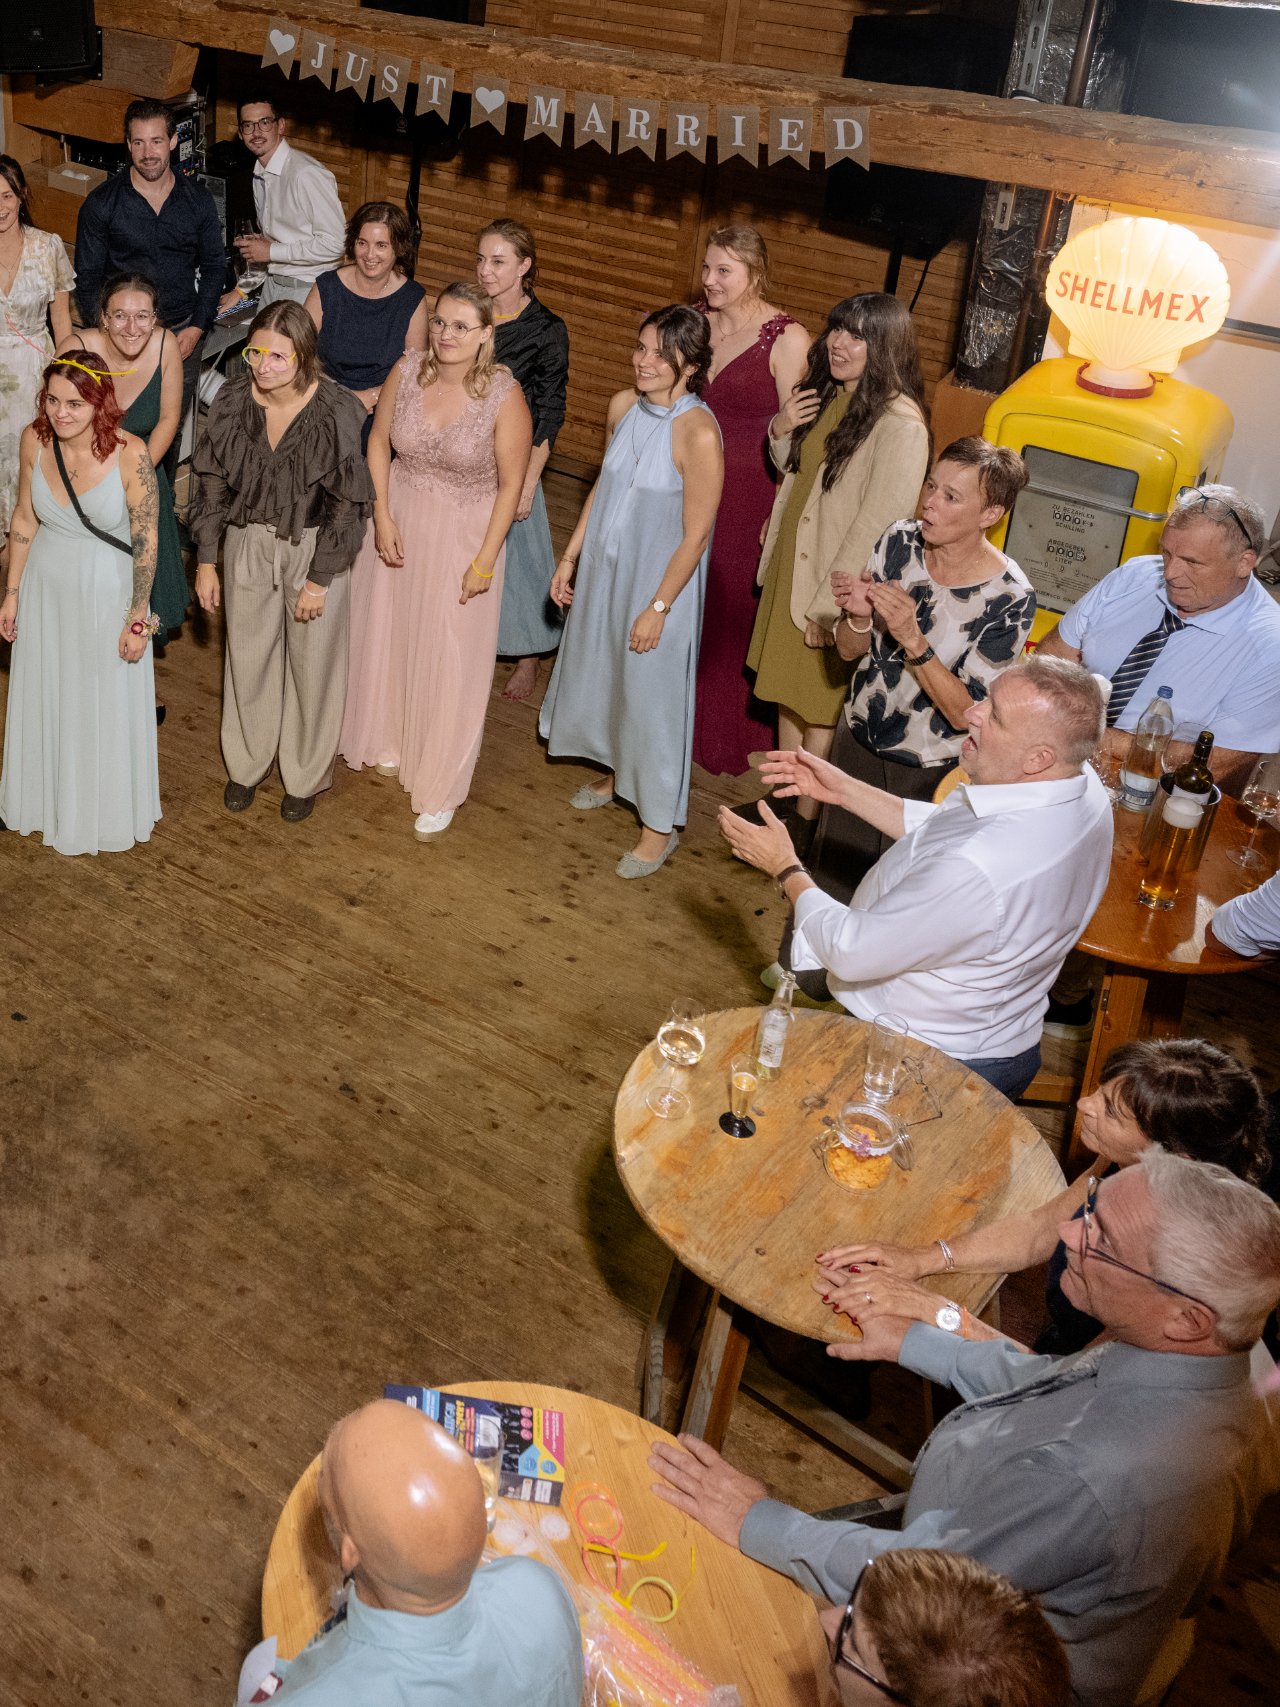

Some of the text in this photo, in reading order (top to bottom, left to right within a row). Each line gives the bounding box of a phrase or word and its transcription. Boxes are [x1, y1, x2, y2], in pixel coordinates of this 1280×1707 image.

[310, 41, 865, 152] JUST MARRIED
[1055, 270, 1211, 324] SHELLMEX
